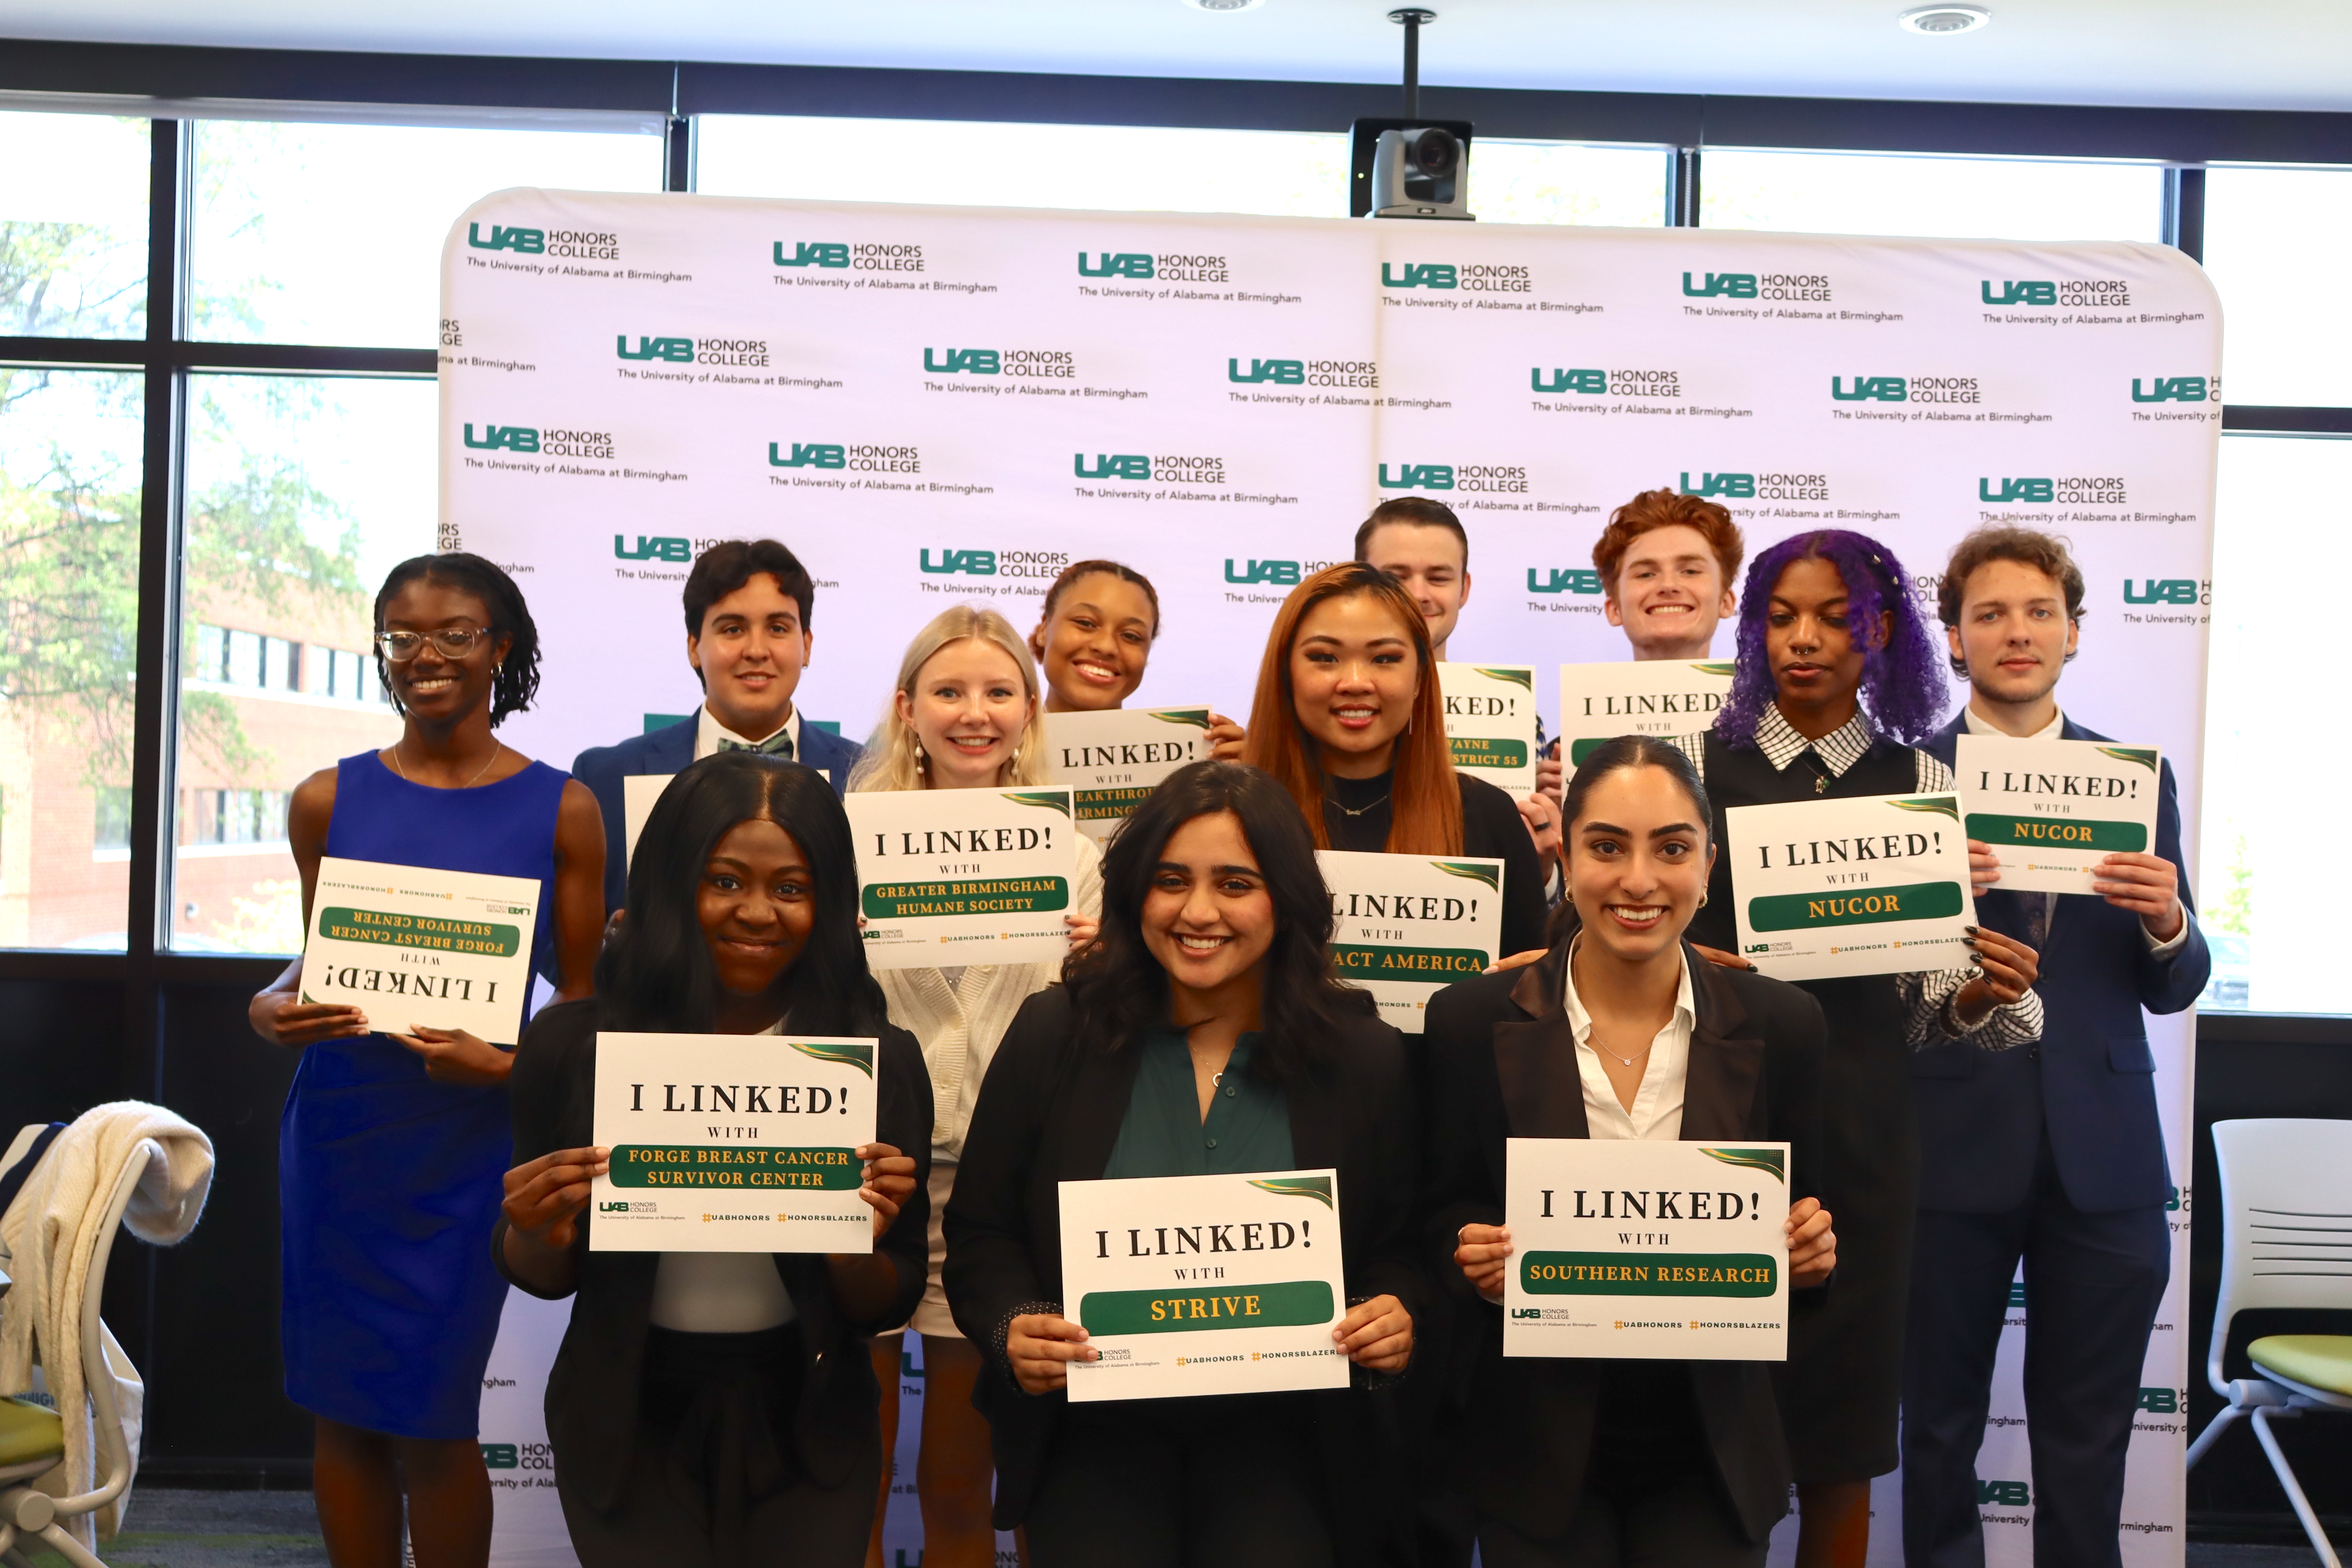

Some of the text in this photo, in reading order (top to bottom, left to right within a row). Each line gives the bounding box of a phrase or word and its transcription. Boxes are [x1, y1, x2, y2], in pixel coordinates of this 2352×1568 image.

[468, 222, 545, 254] UAB
[549, 230, 616, 245] HONORS
[548, 244, 619, 260] COLLEGE
[467, 256, 486, 267] The
[490, 260, 544, 275] University
[547, 265, 559, 274] of
[562, 266, 609, 277] Alabama
[628, 269, 692, 283] Birmingham
[1982, 280, 2057, 305] UAB
[2061, 281, 2127, 292] HONORS
[2060, 294, 2130, 306] COLLEGE
[1983, 312, 2204, 326] The University of Alabama at Birmingham
[924, 347, 1000, 374] UAB
[1005, 350, 1072, 364] HONORS
[1004, 364, 1074, 377] COLLEGE
[924, 381, 944, 391] The
[947, 383, 1001, 396] University
[1004, 384, 1016, 394] of
[1019, 385, 1066, 396] Alabama
[1084, 387, 1148, 400] Birmingham
[1832, 376, 1906, 401] UAB
[1911, 377, 1978, 390] HONORS
[1911, 391, 1980, 403] COLLEGE
[1832, 410, 1851, 419] The
[1855, 410, 1907, 423] University
[1911, 411, 1922, 420] of
[1925, 411, 1971, 421] Alabama
[1989, 412, 2053, 424] Birmingham
[1075, 454, 1151, 479] UAB
[1155, 456, 1222, 469] HONORS
[1154, 470, 1225, 483] COLLEGE
[1074, 487, 1094, 497] The
[1098, 488, 1151, 501] University
[1154, 490, 1166, 499] of
[1169, 491, 1216, 501] Alabama
[1234, 493, 1298, 506] Birmingham
[1584, 693, 1720, 715] I LINKED
[1636, 723, 1671, 731] WITH
[1062, 741, 1194, 768] LINKED!
[1504, 756, 1517, 765] 55
[1096, 774, 1132, 784] WITH
[1980, 771, 2137, 799] I LINKED!
[2034, 803, 2070, 813] WITH
[2014, 823, 2092, 841] NUCOR
[875, 827, 1051, 856] I LINKED!
[1759, 832, 1941, 869] I LINKED!
[939, 864, 980, 874] WITH
[1826, 872, 1868, 884] WITH
[877, 880, 1055, 898] GREATER BIRMINGHAM
[508, 907, 530, 915] UAB
[897, 898, 1033, 915] HUMANE SOCIETY
[1809, 895, 1900, 918] NUCOR
[354, 912, 491, 936] SURVIVOR CENTER
[331, 926, 503, 953] FORGE BREAST CANCER
[1361, 929, 1402, 940] WITH
[1745, 944, 1769, 953] UAB
[401, 953, 440, 965] WITH
[1381, 954, 1484, 973] AMERICA
[325, 965, 498, 1003] I LINKED!
[630, 1084, 847, 1115] I LINKED!
[707, 1127, 757, 1138] WITH
[629, 1150, 848, 1165] FORGE BREAST CANCER
[648, 1171, 823, 1186] SURVIVOR CENTER
[599, 1202, 629, 1212] UAB
[1541, 1190, 1759, 1221] I LINKED!
[1095, 1220, 1310, 1258] I LINKED!
[1618, 1233, 1669, 1245] WITH
[1174, 1267, 1224, 1280] WITH
[1530, 1265, 1769, 1282] SOUTHERN RESEARCH
[1151, 1295, 1260, 1320] STRIVE
[1512, 1309, 1541, 1319] UAB
[902, 1386, 921, 1395] The
